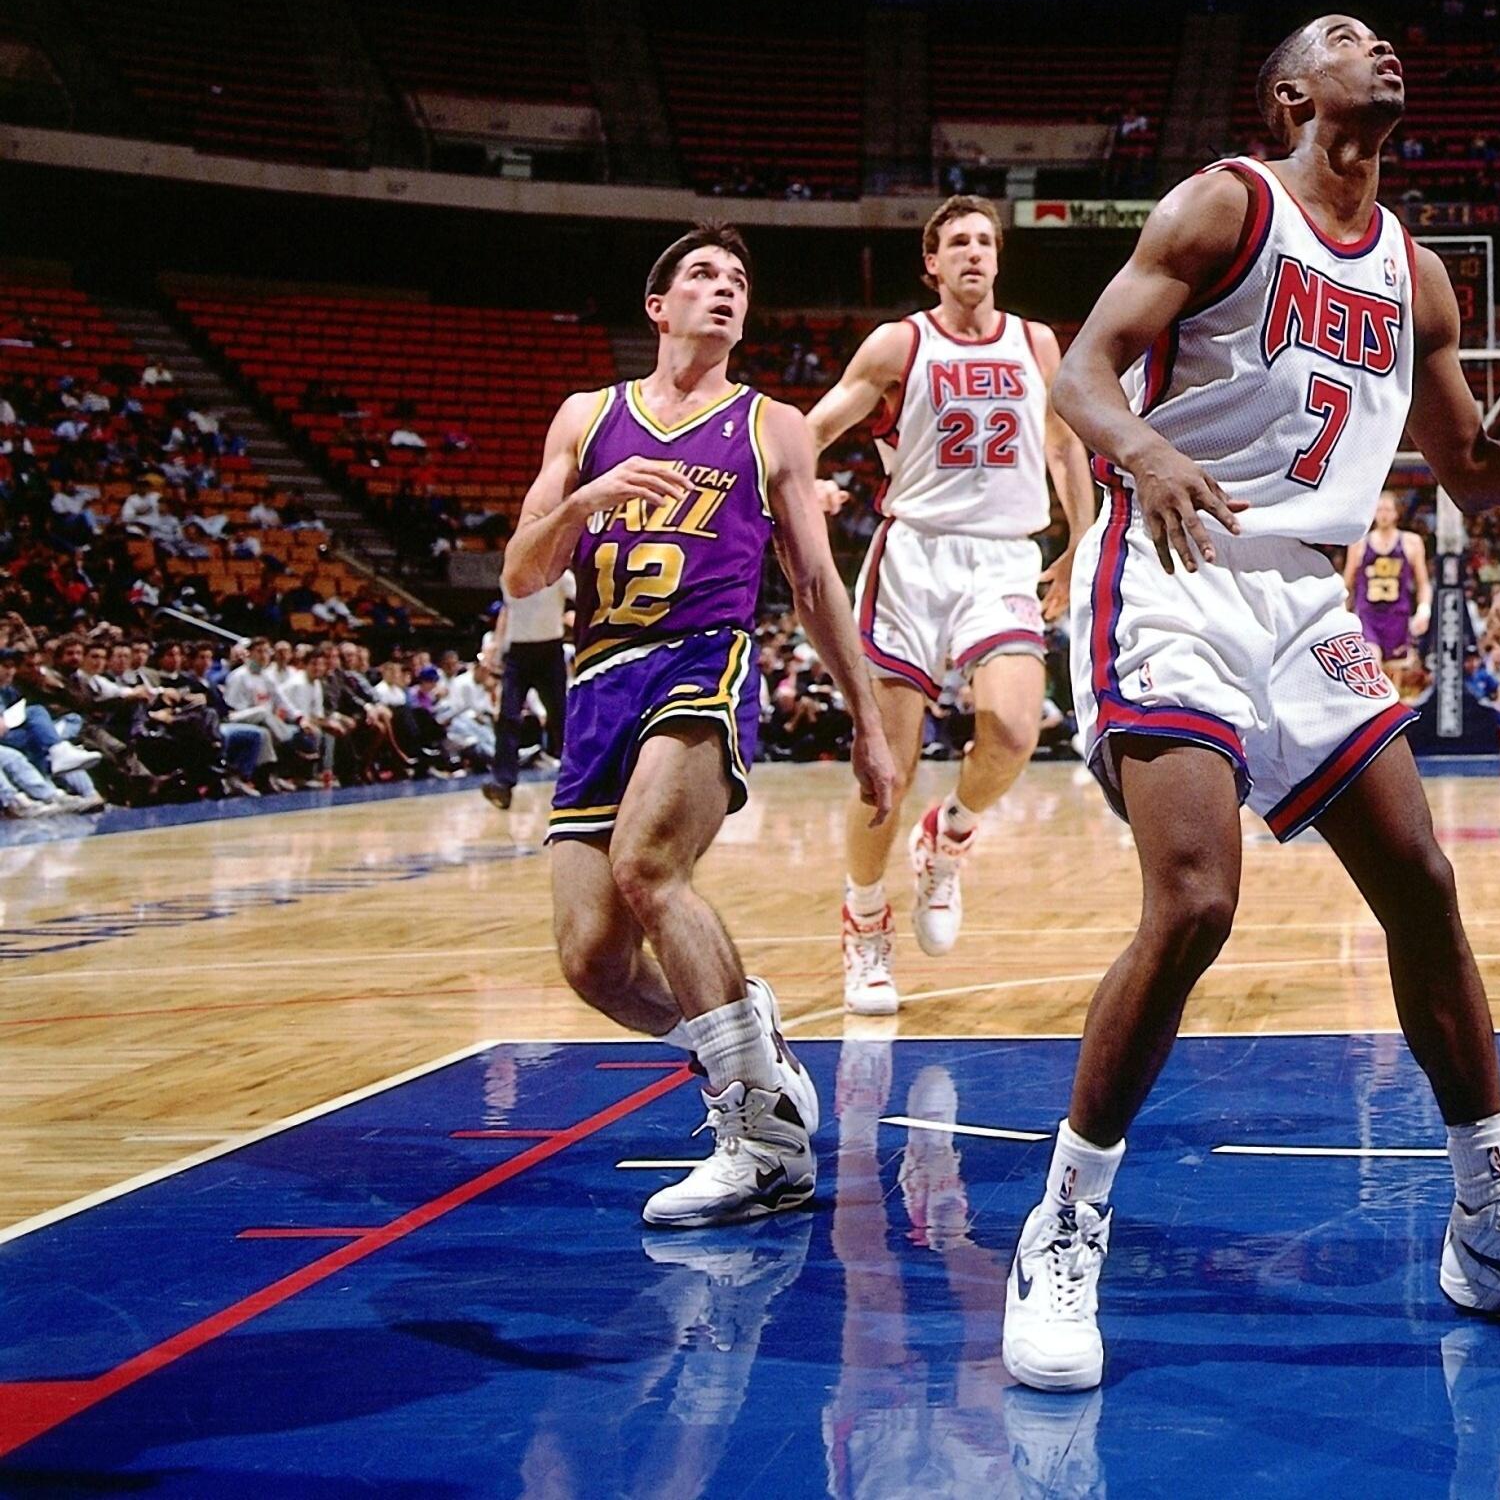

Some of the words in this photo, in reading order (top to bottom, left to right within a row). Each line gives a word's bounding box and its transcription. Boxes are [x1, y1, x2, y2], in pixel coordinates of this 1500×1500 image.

[1262, 253, 1402, 377] NETS
[927, 359, 1028, 414] NETS
[936, 407, 1021, 469] 22
[1286, 372, 1352, 489] 7
[682, 463, 738, 490] UTAH
[588, 542, 686, 628] 12
